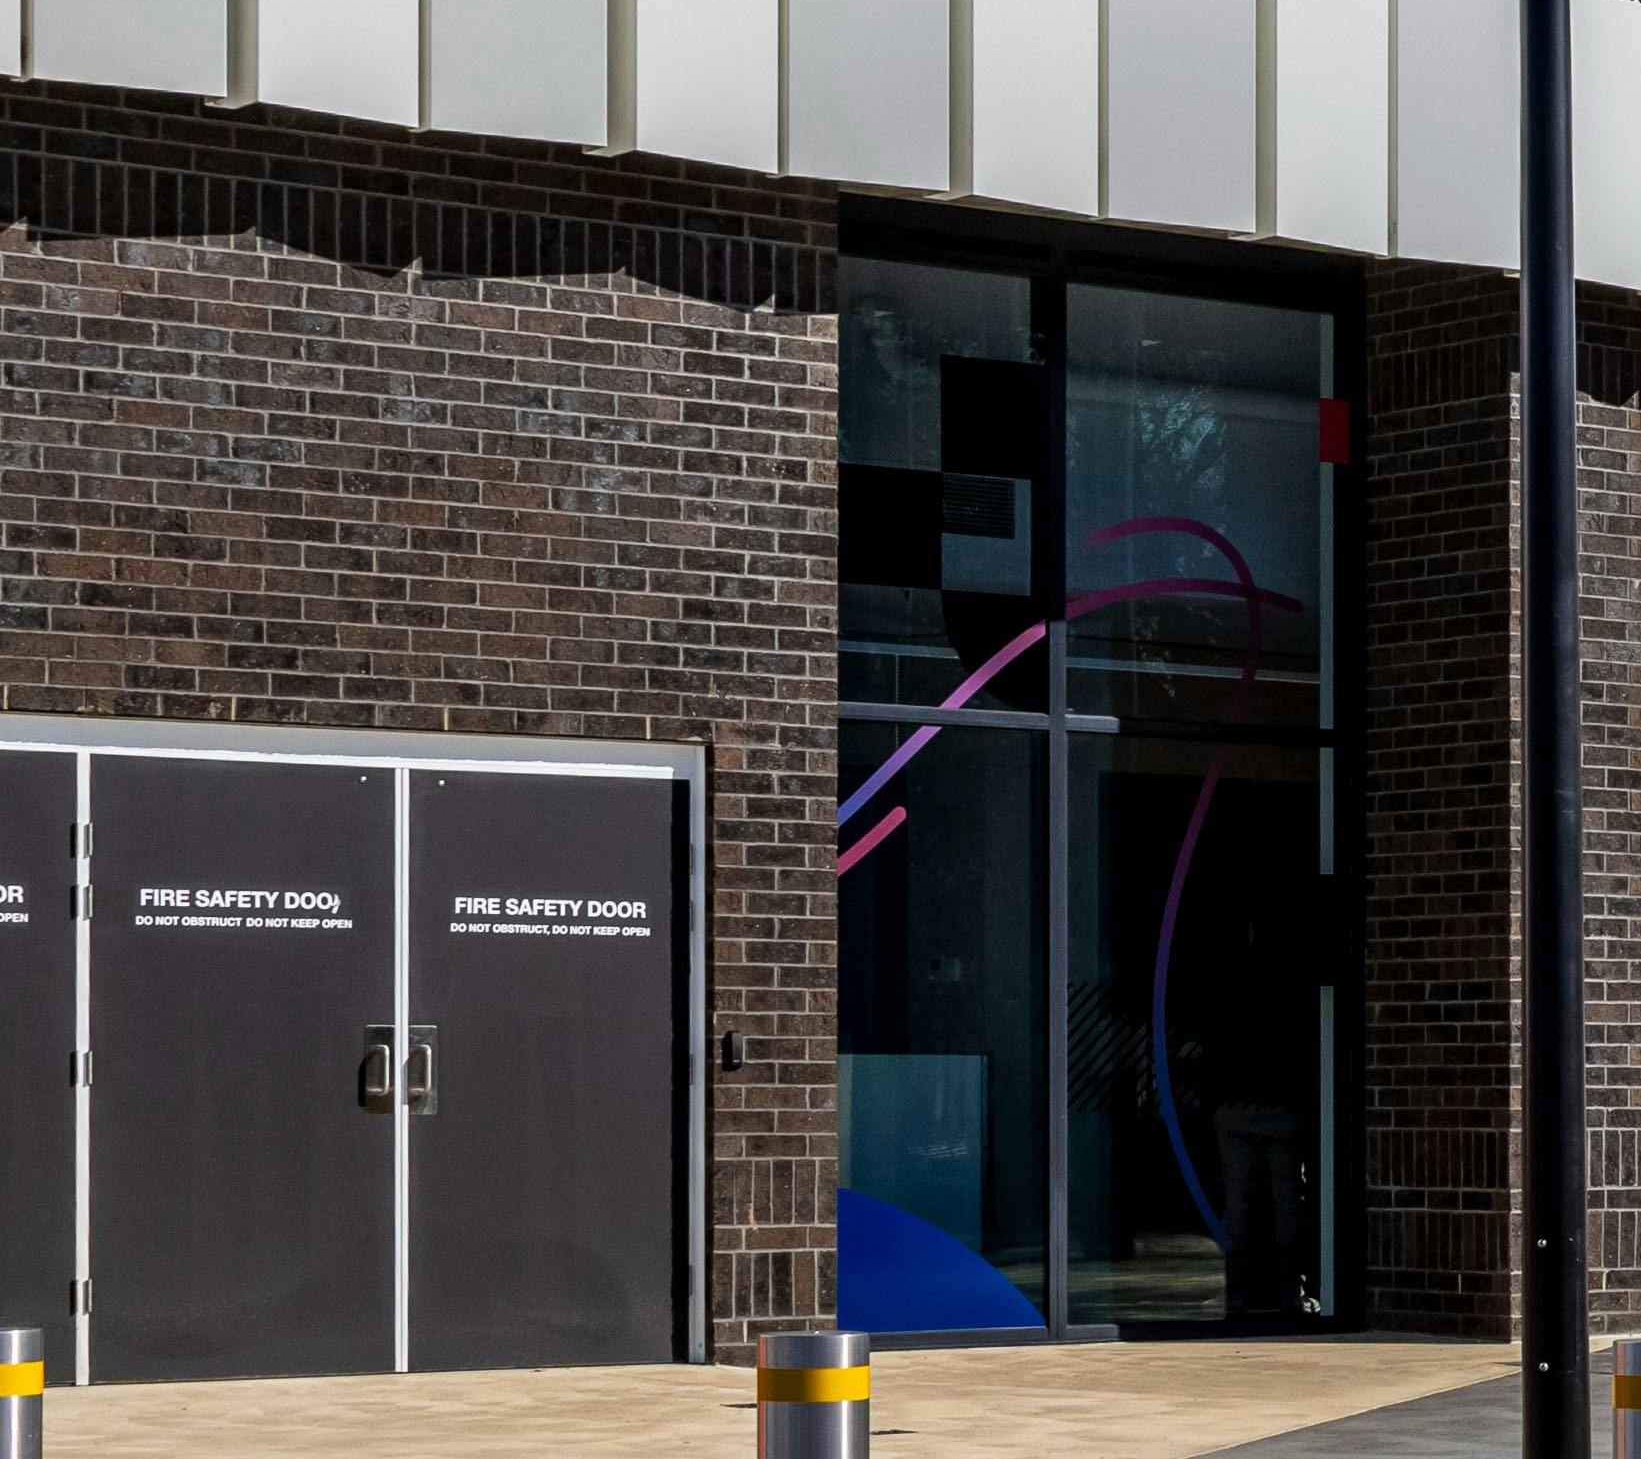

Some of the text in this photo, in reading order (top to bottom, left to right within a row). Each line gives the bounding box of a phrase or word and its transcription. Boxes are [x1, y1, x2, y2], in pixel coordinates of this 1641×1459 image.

[140, 888, 190, 907] FIRE
[195, 889, 279, 909] SAFETY
[454, 897, 647, 919] FIRE SAFETY DOOR
[135, 915, 154, 926] DO
[155, 916, 179, 926] NOT
[246, 918, 263, 928] DO
[265, 918, 289, 929] NOT
[290, 918, 320, 929] KEEP
[321, 919, 353, 930] OPEN
[450, 922, 467, 933] DO
[468, 923, 491, 934] NOT
[552, 925, 569, 935] DO
[569, 925, 592, 936] NOT
[593, 926, 621, 937] KEEP
[622, 927, 651, 937] OPEN
